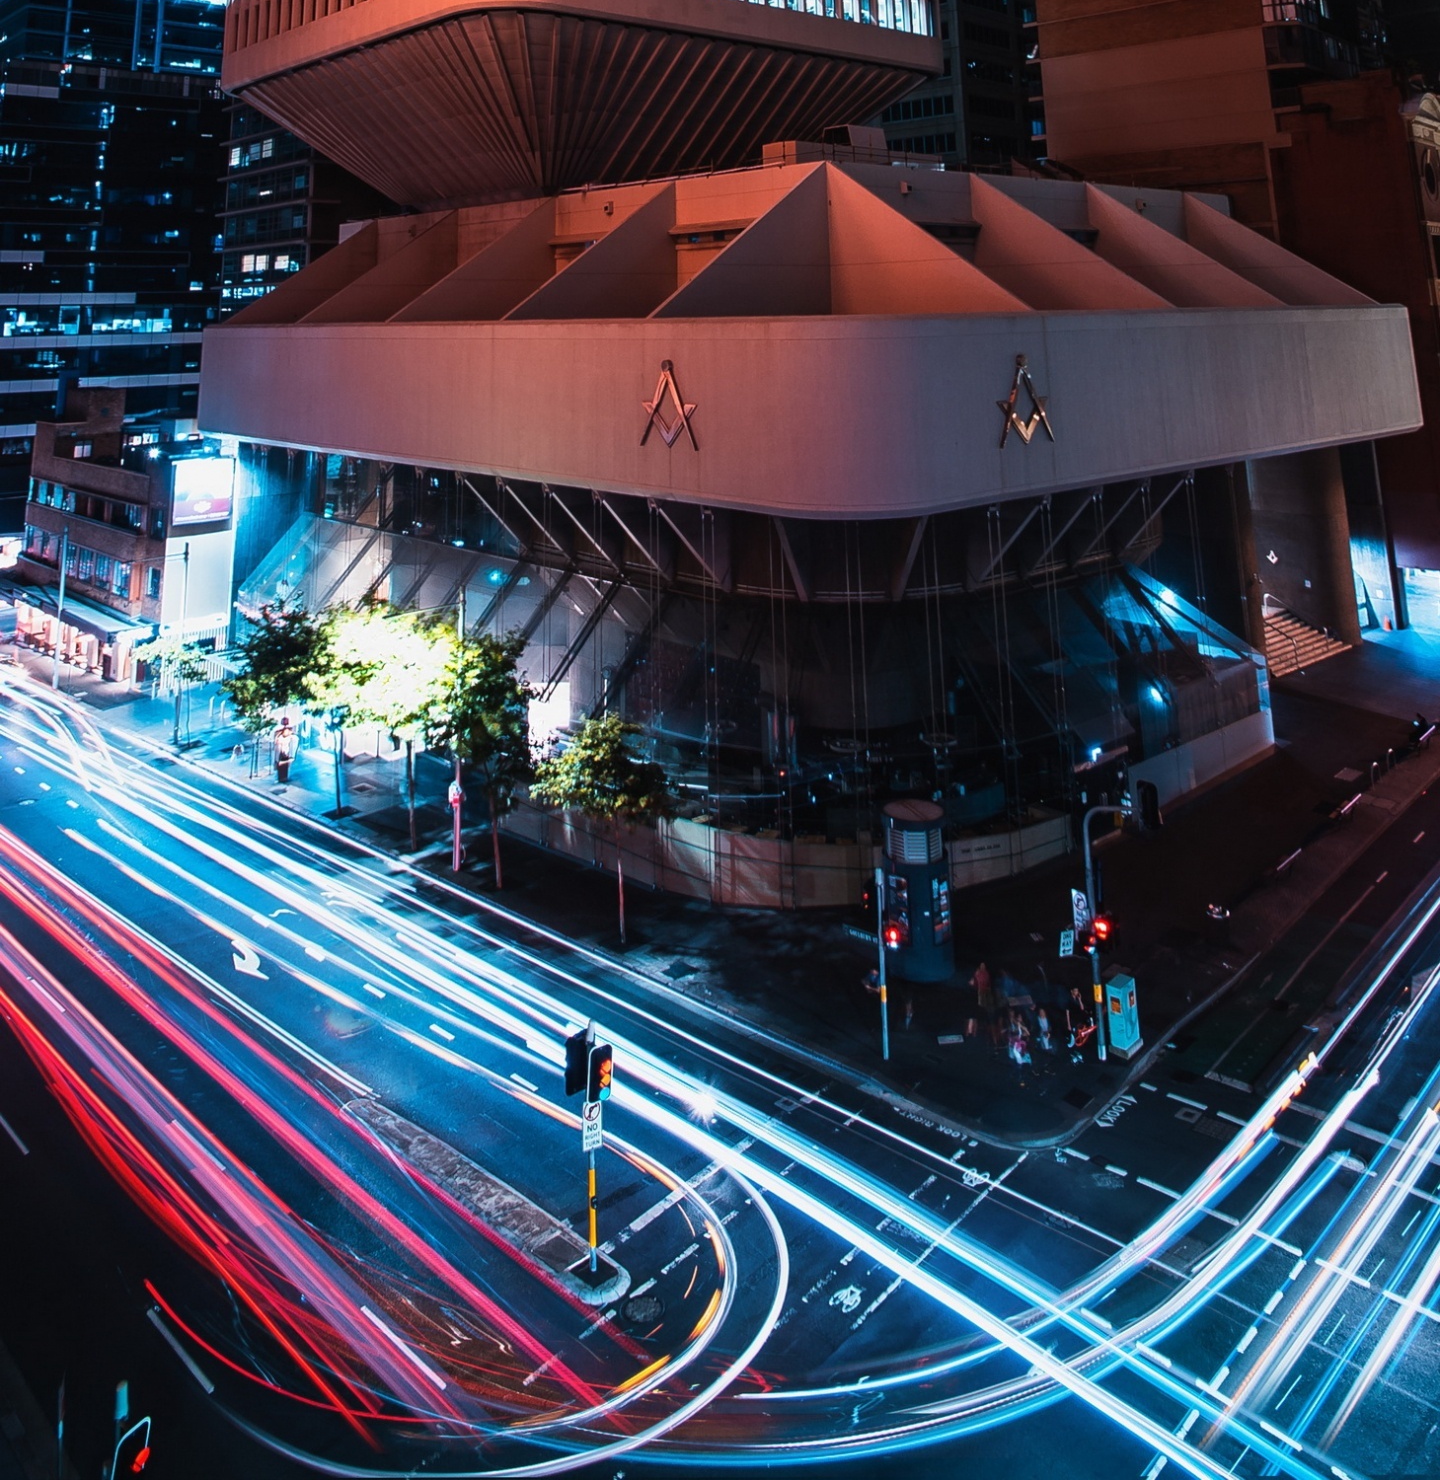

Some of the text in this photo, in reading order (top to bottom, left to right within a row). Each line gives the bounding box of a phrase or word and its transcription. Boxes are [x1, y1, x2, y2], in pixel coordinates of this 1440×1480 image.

[1100, 1100, 1132, 1123] LOOK
[587, 1123, 598, 1132] NO
[936, 1125, 968, 1141] LOOK
